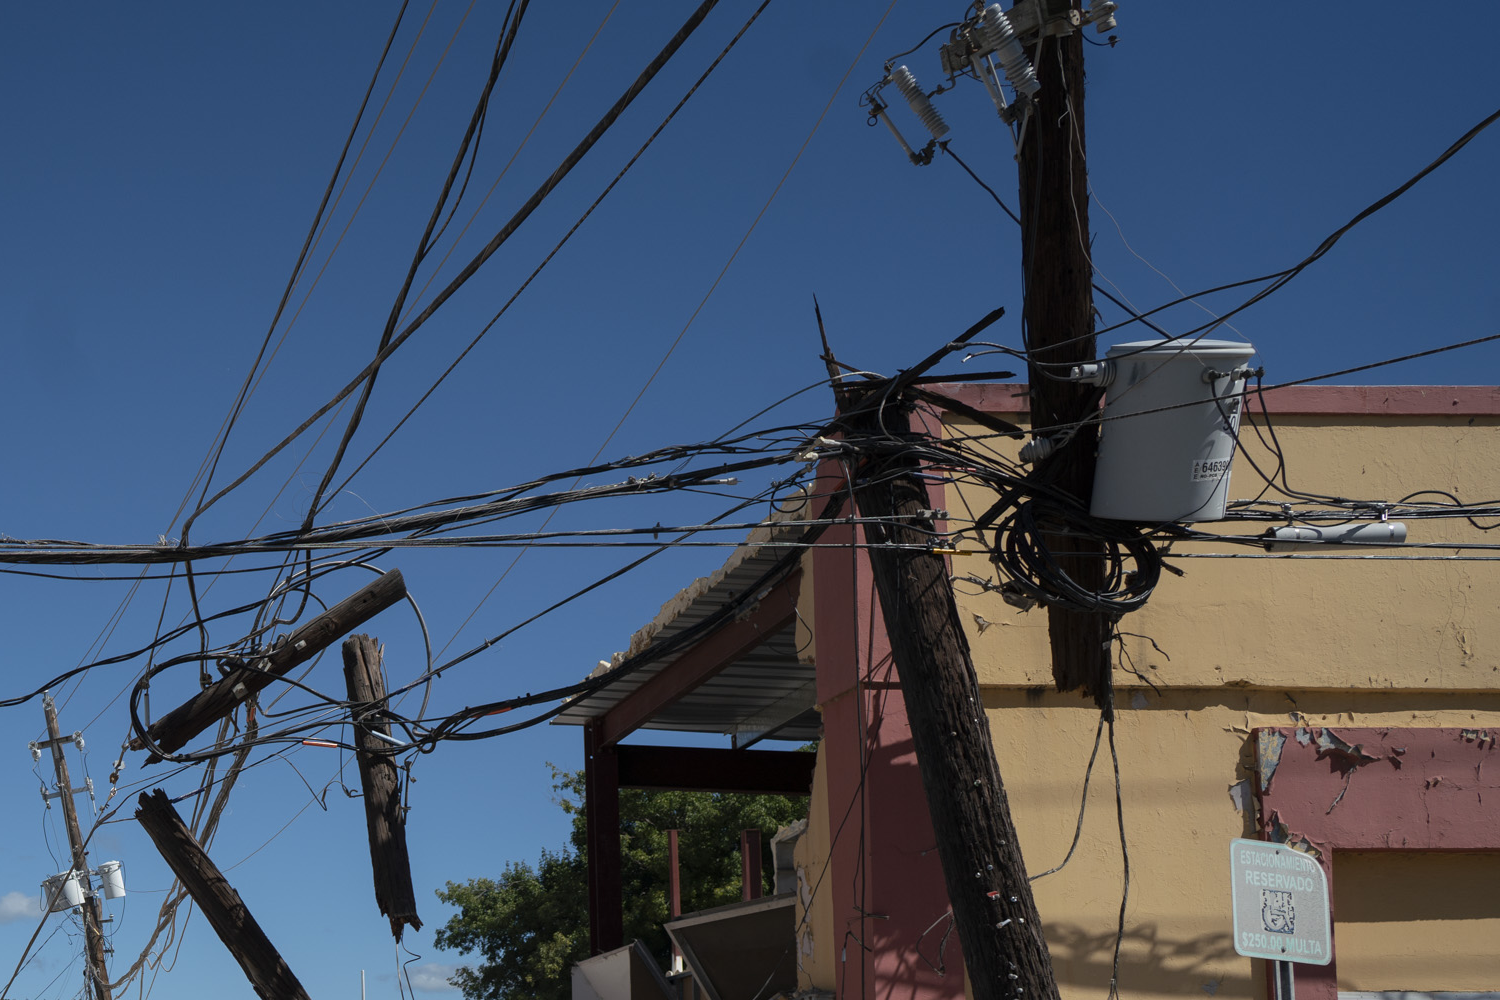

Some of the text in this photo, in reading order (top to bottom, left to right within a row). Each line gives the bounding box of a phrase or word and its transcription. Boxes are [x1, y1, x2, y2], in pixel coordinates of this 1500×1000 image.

[1240, 850, 1316, 873] ESTACIONAMIENTO
[1245, 870, 1313, 892] RESERVADO
[1242, 932, 1323, 955] $250.00 MULTA
